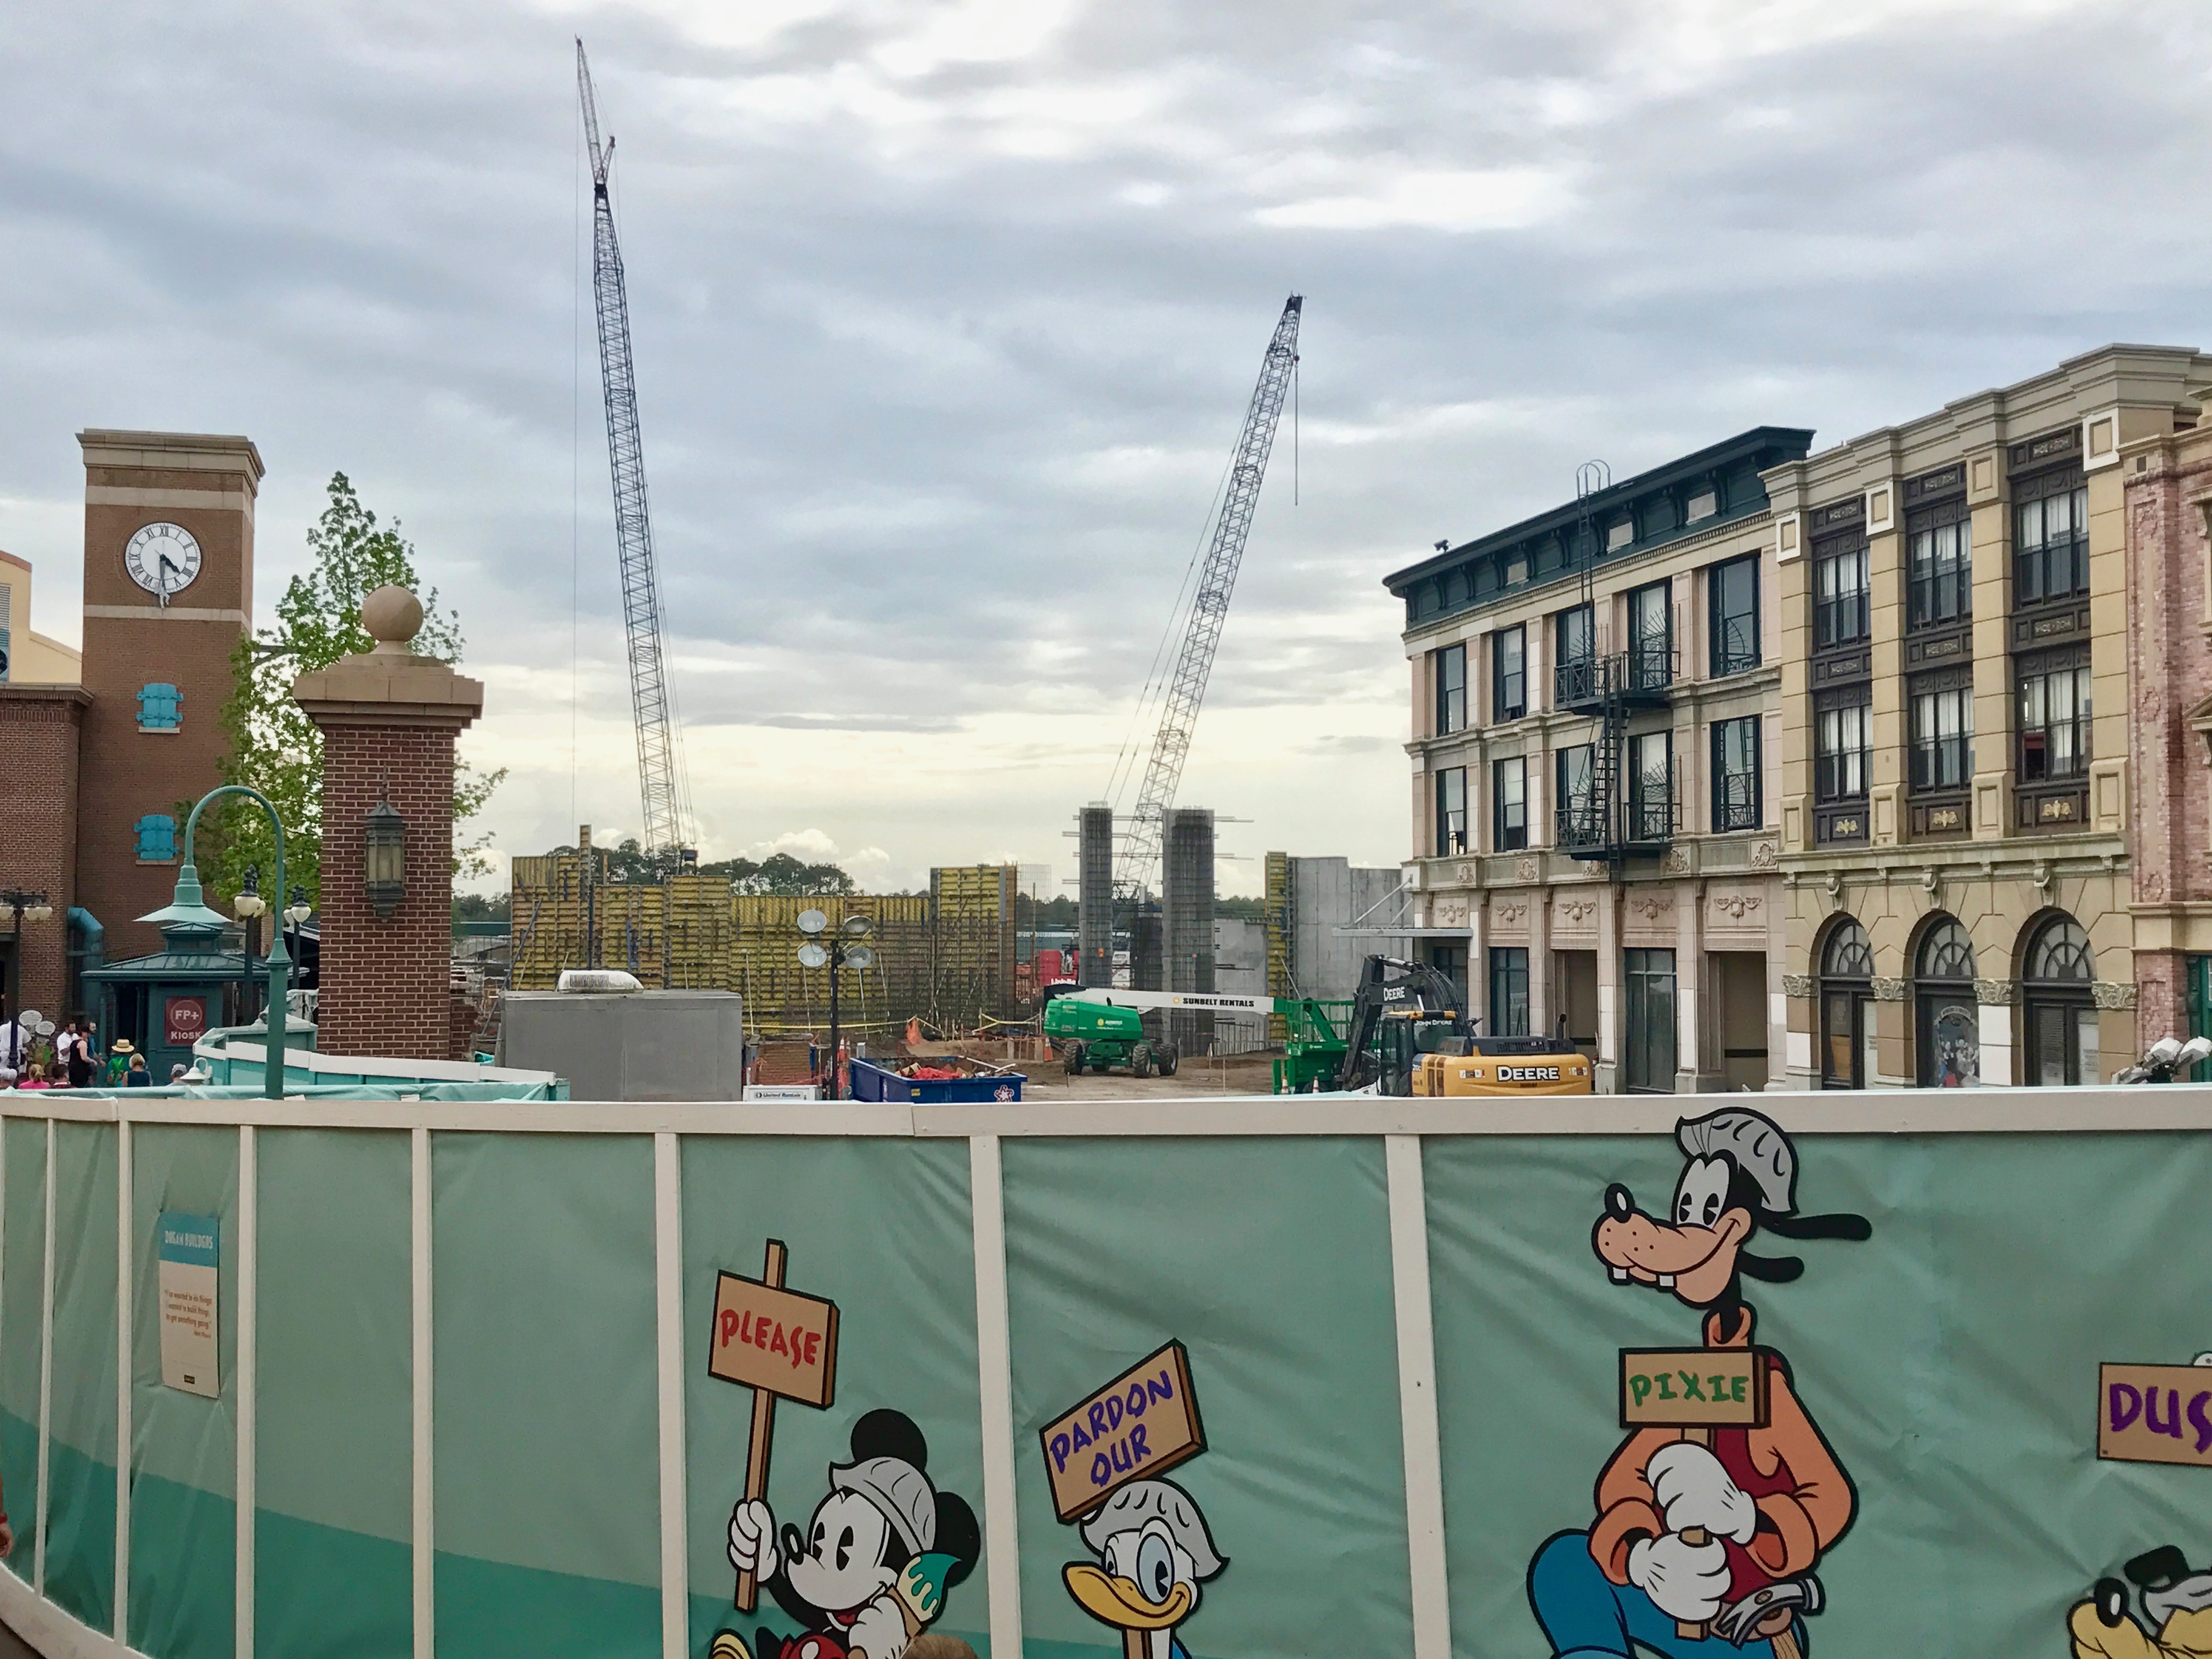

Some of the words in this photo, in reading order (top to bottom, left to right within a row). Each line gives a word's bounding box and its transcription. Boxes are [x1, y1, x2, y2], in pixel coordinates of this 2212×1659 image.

[1183, 997, 1218, 1006] SUNBELT
[1219, 999, 1255, 1007] RENTALS
[1383, 986, 1406, 1002] DEERE
[175, 1010, 199, 1020] FP+
[171, 1031, 202, 1040] KIOSK
[1497, 1065, 1560, 1081] DEERE
[720, 1308, 822, 1369] PLEASE
[1629, 1370, 1749, 1407] PIXIE
[1049, 1370, 1173, 1475] PARDON
[2109, 1383, 2212, 1455] DUS
[1091, 1424, 1152, 1488] OUR
